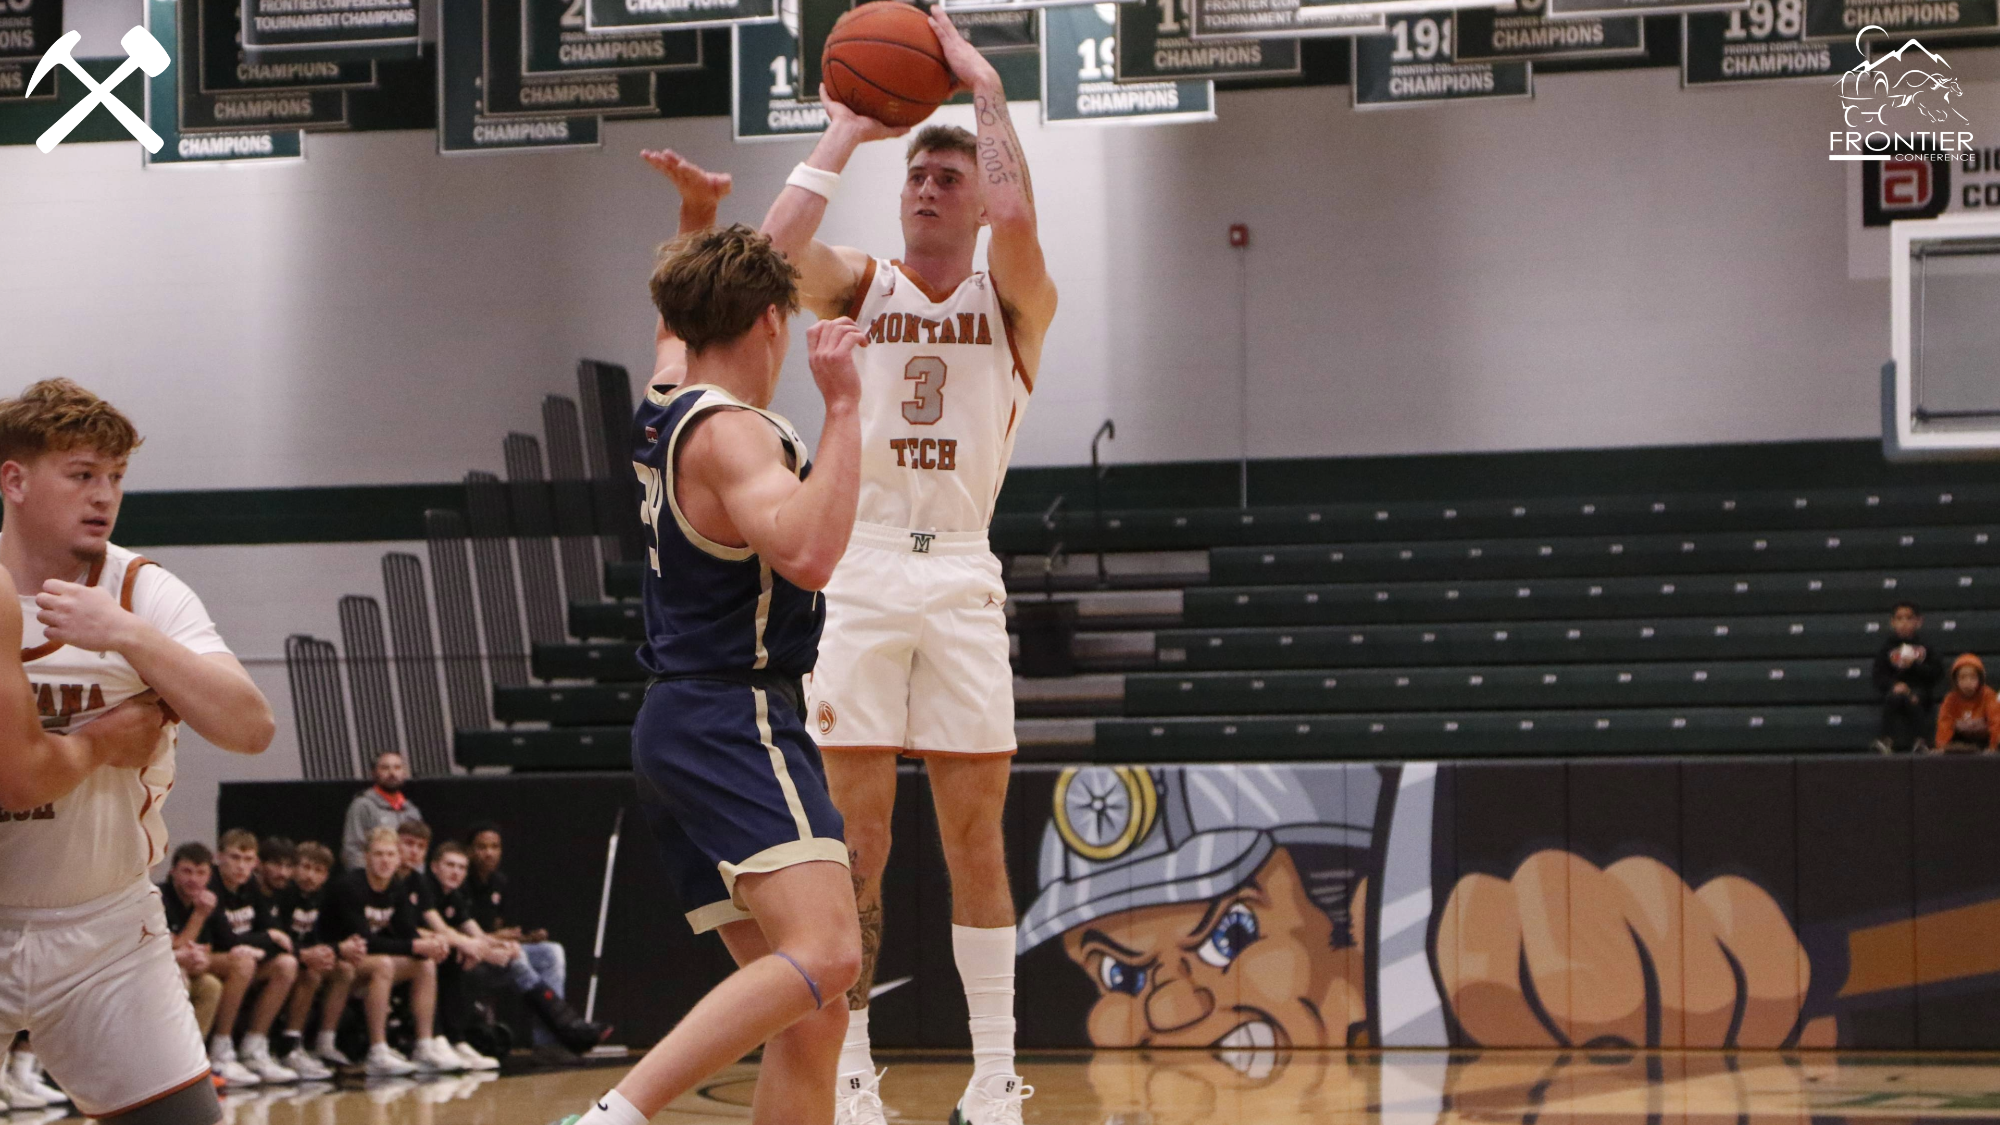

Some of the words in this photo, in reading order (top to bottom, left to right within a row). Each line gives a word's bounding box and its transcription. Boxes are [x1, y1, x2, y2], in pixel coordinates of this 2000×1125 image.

[254, 12, 341, 31] TOURNAMENT
[341, 8, 417, 27] CHAMPIONS
[1204, 10, 1293, 28] TOURNAMENT
[1843, 2, 1960, 27] CHAMPIONS
[1492, 23, 1604, 50] CHAMPIONS
[559, 40, 665, 64] CHAMPIONS
[1154, 45, 1262, 71] CHAMPIONS
[1722, 50, 1831, 75] CHAMPIONS
[236, 61, 341, 82] CHAMPIONS
[1389, 70, 1495, 96] CHAMPIONS
[519, 83, 620, 105] CHAMPIONS
[1077, 89, 1179, 115] CHAMPIONS
[213, 98, 312, 120] CHAMPIONS
[473, 121, 570, 144] CHAMPIONS
[178, 134, 274, 158] CHAMPIONS
[867, 312, 992, 345] MONTANA
[901, 355, 948, 426] 3
[890, 437, 958, 471] TECH
